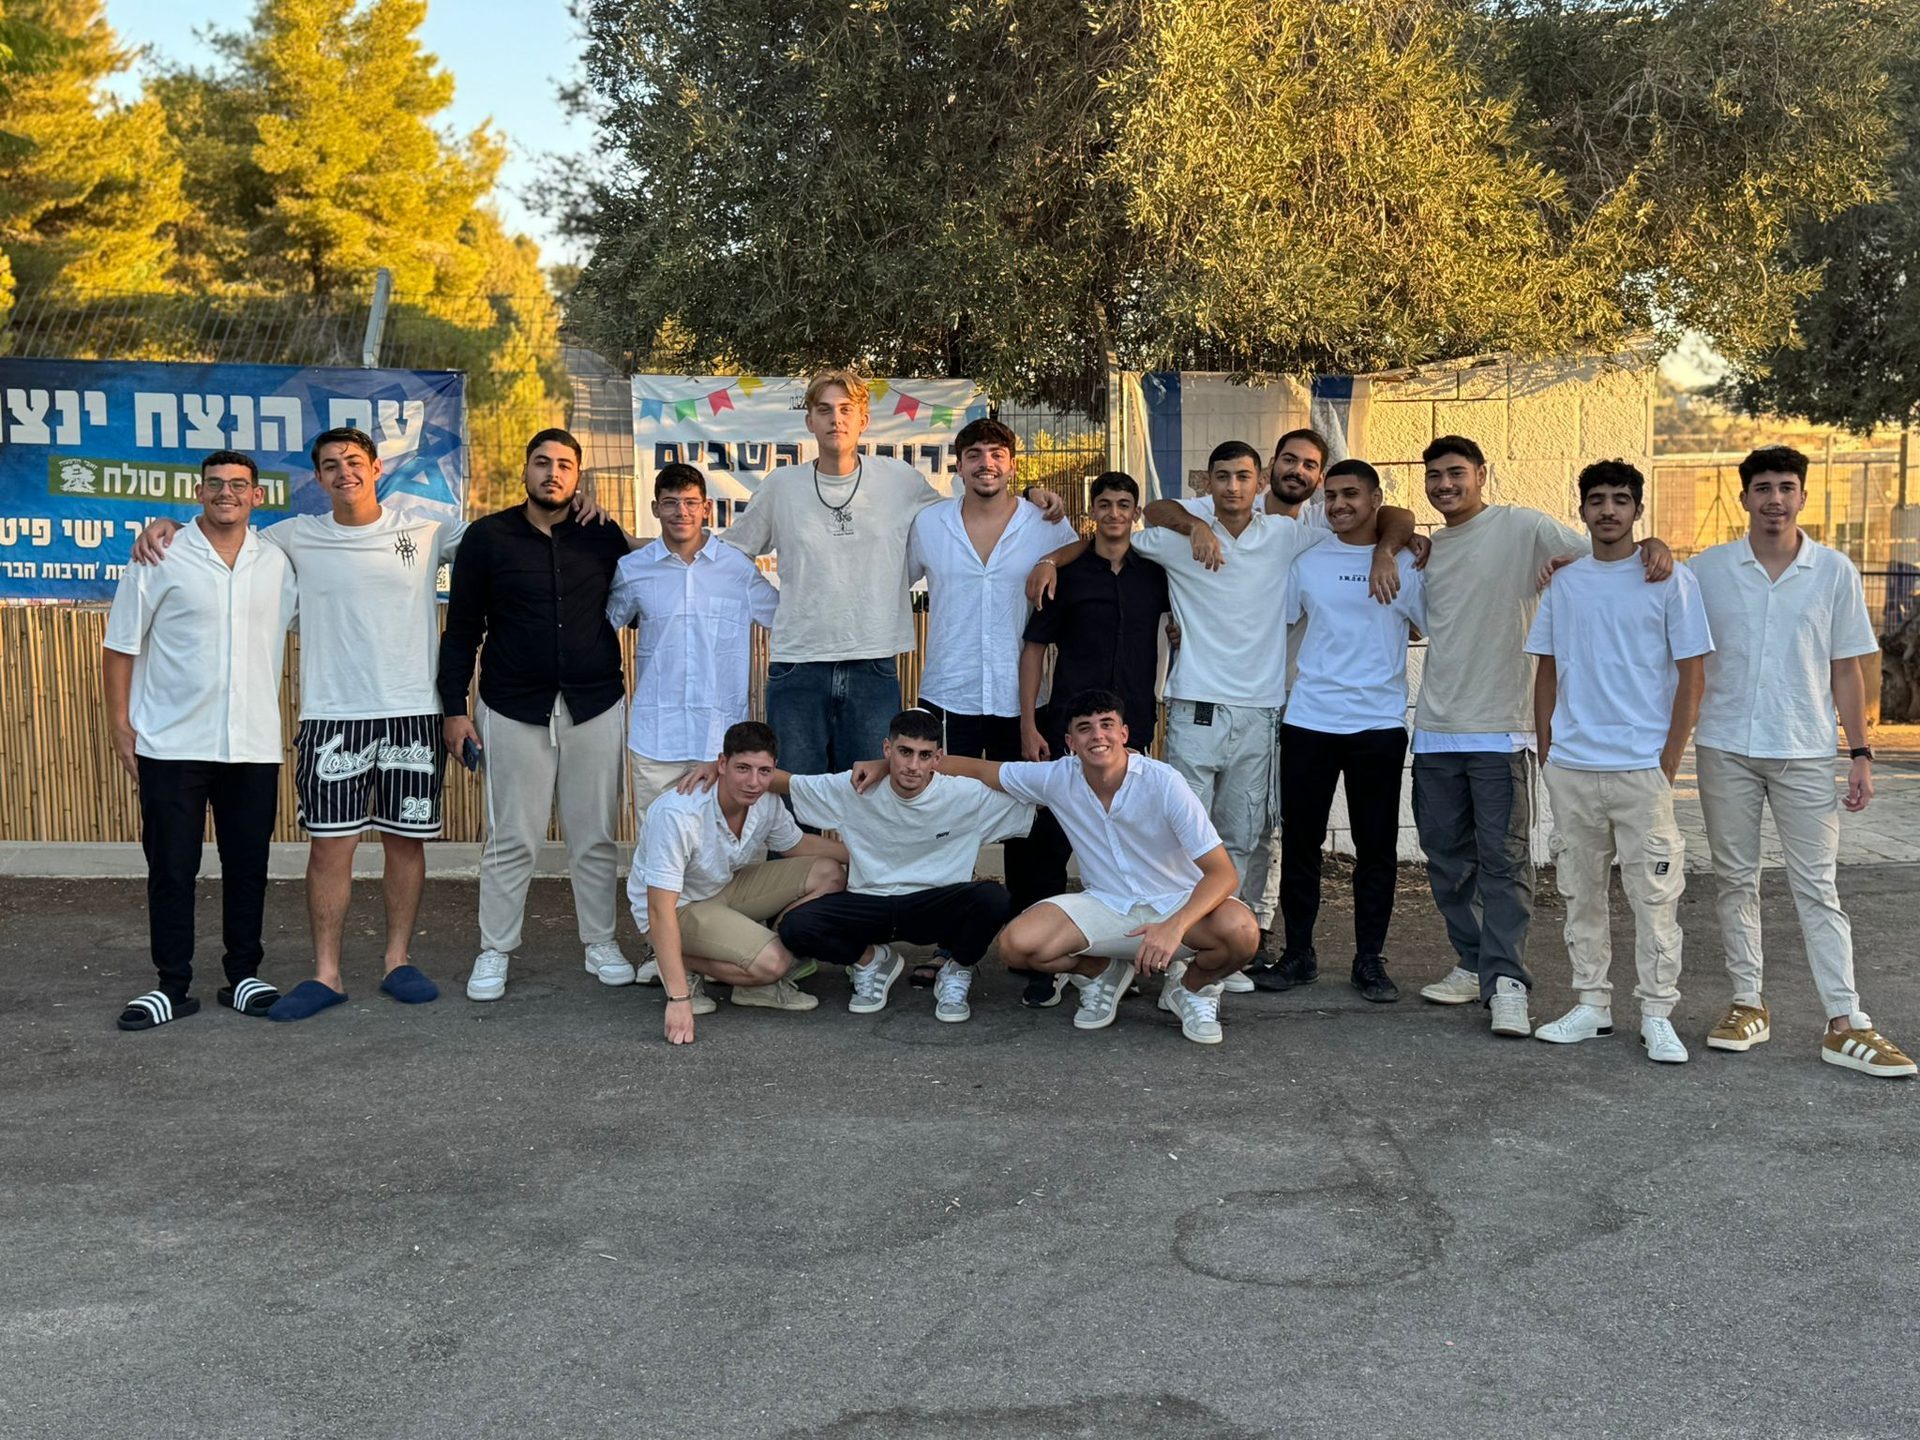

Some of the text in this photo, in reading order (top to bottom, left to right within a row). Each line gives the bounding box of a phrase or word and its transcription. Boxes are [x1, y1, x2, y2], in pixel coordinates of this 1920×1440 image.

[0, 388, 424, 461] עם הנצח ינצ
[654, 441, 803, 472] השבים
[103, 462, 166, 498] סולח
[62, 519, 114, 548] ישי
[0, 561, 37, 579] הבר
[315, 733, 434, 781] Los Angeles
[402, 797, 432, 821] 23
